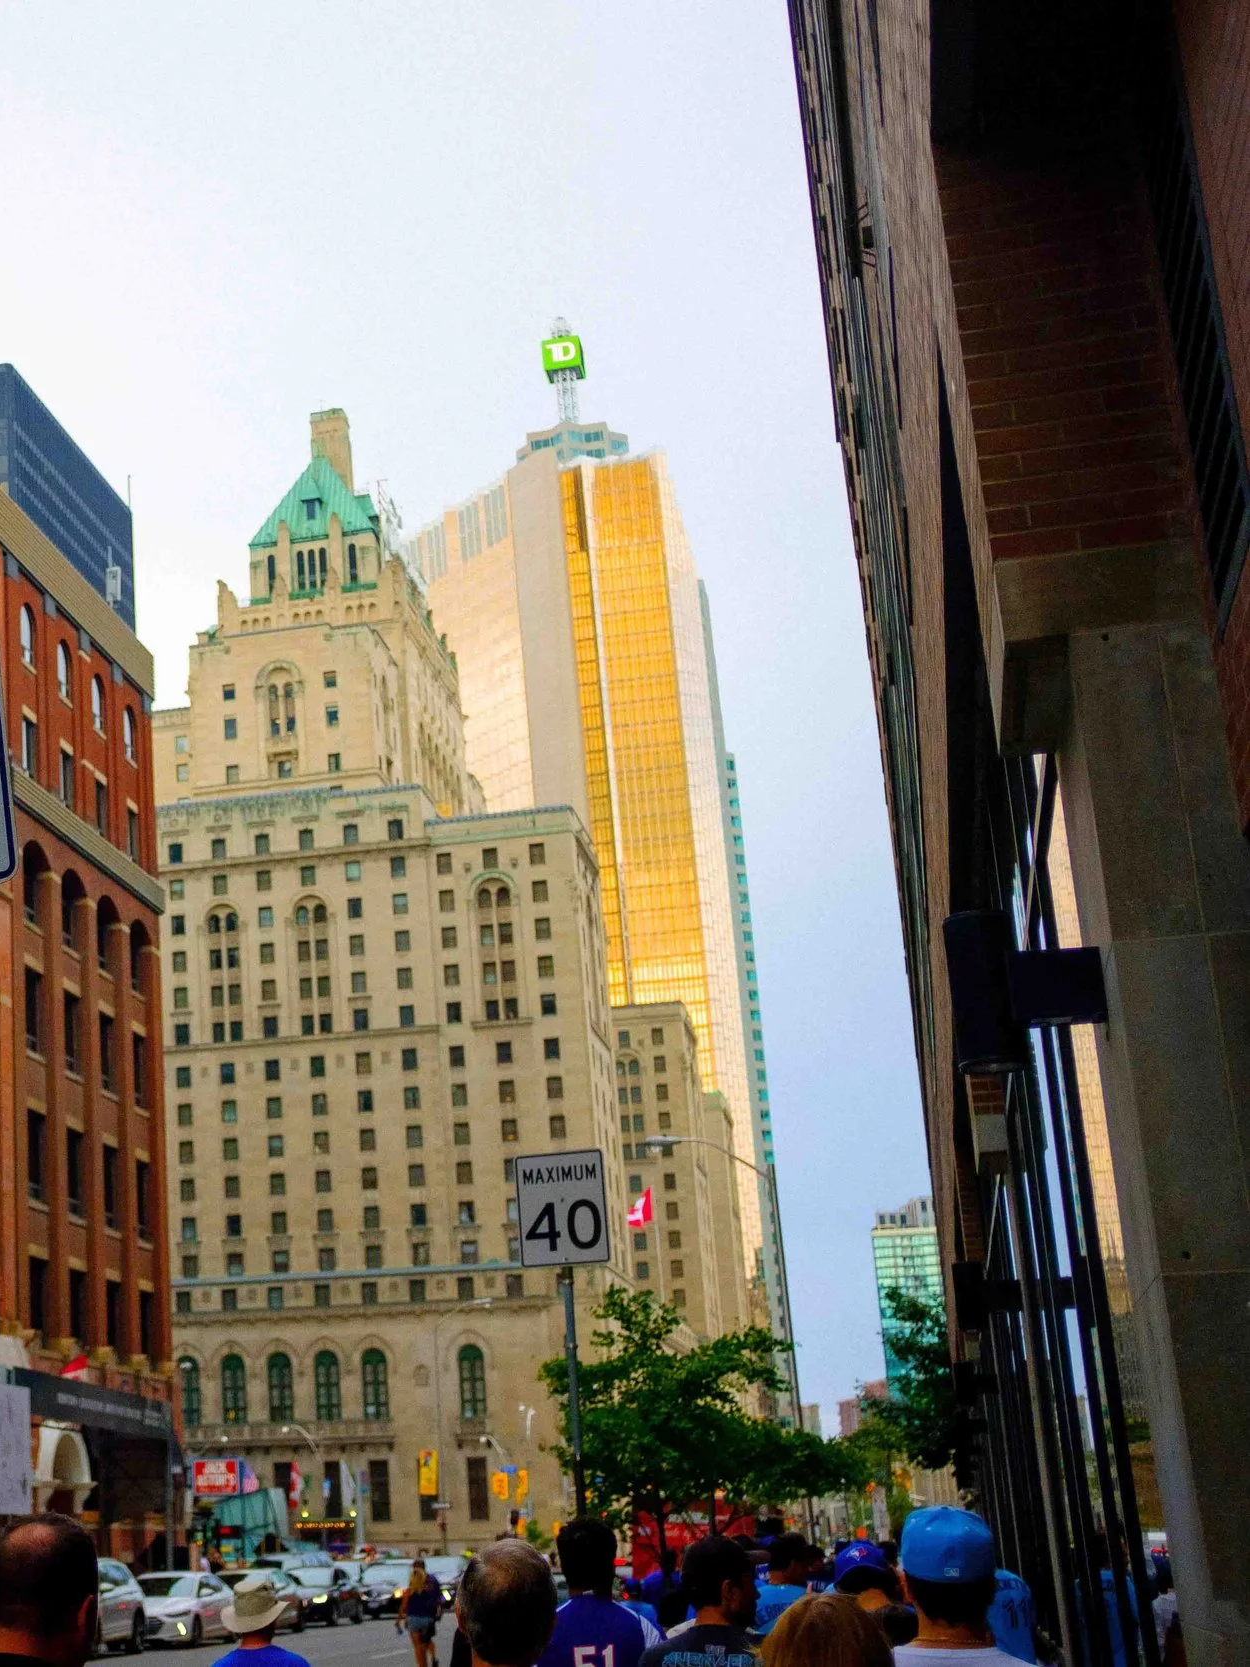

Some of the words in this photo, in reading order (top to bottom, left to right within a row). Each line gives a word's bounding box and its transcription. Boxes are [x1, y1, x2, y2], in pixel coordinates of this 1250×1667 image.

[545, 341, 576, 362] TD
[522, 1163, 597, 1185] MAXIMUM
[525, 1198, 601, 1251] 40
